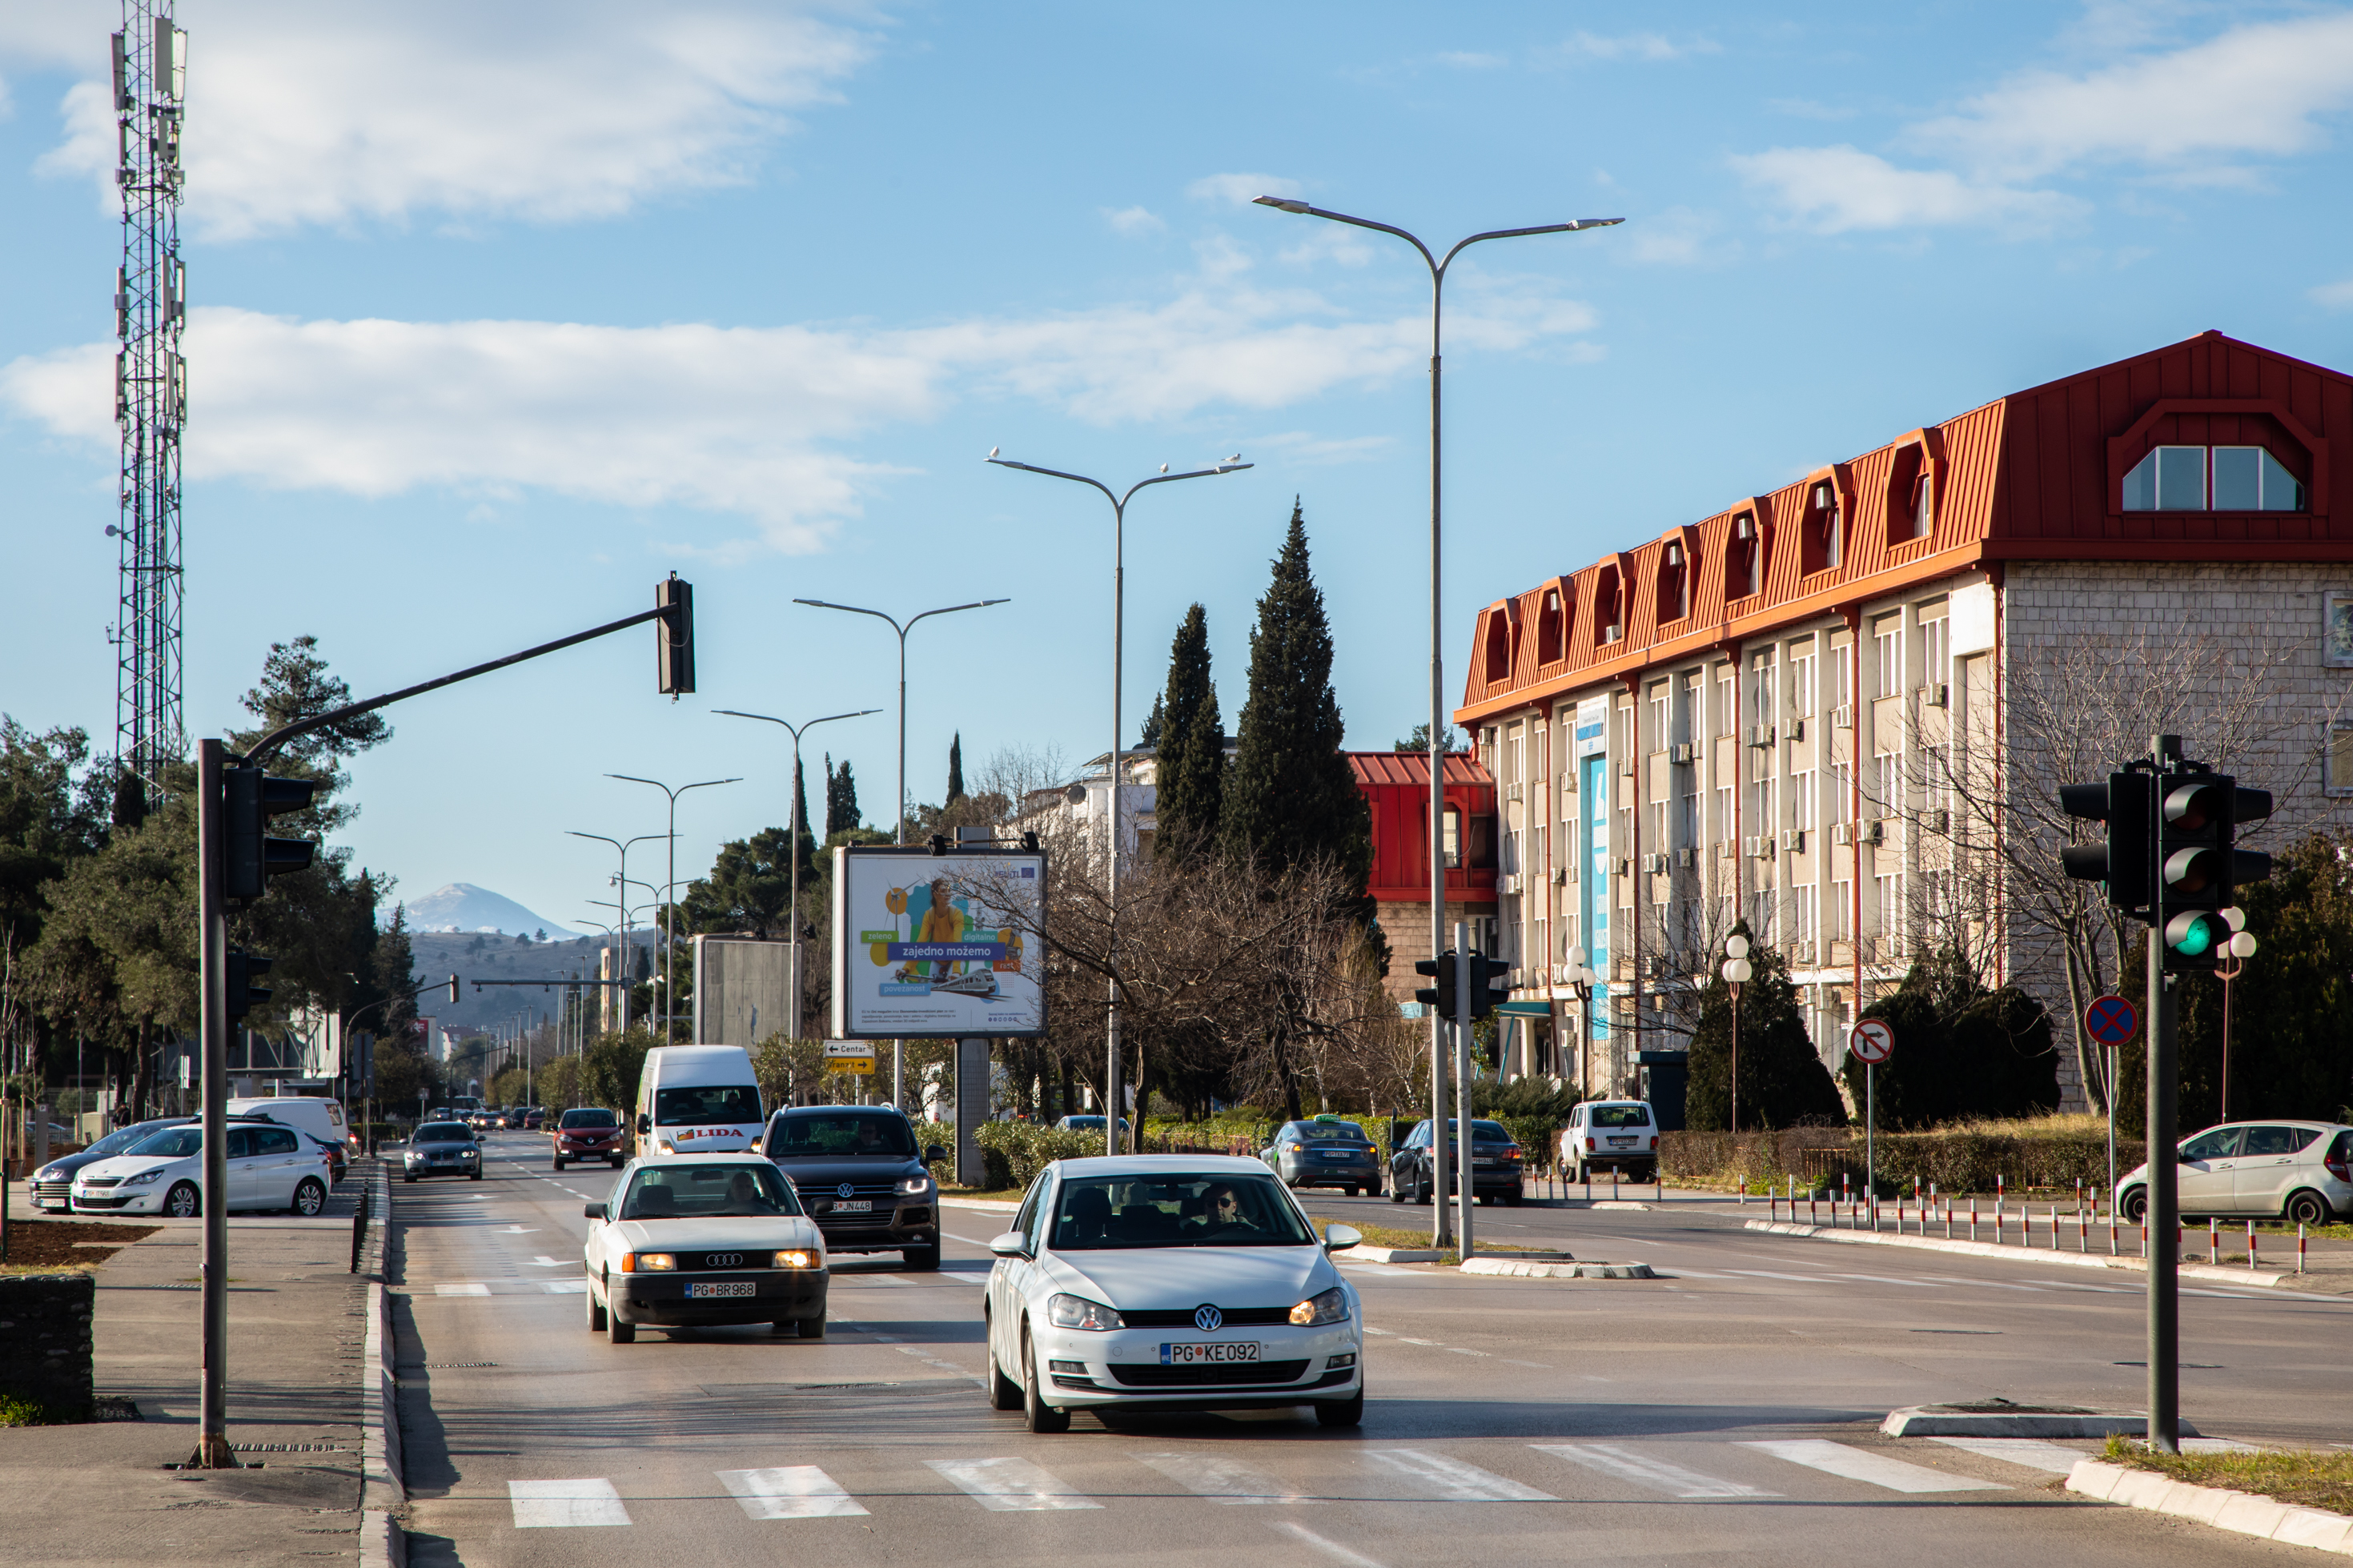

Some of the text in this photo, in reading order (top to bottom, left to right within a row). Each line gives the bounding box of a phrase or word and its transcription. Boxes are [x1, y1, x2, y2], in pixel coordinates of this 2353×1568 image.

[964, 933, 996, 942] digitalno
[903, 945, 991, 958] zajedno možemo
[884, 985, 925, 993] povezanost
[696, 1129, 745, 1137] LIDA
[843, 1202, 870, 1211] JN448
[694, 1284, 708, 1296] PG
[716, 1284, 754, 1296] BR968
[1173, 1346, 1193, 1362] PG
[1205, 1345, 1257, 1361] KE092
